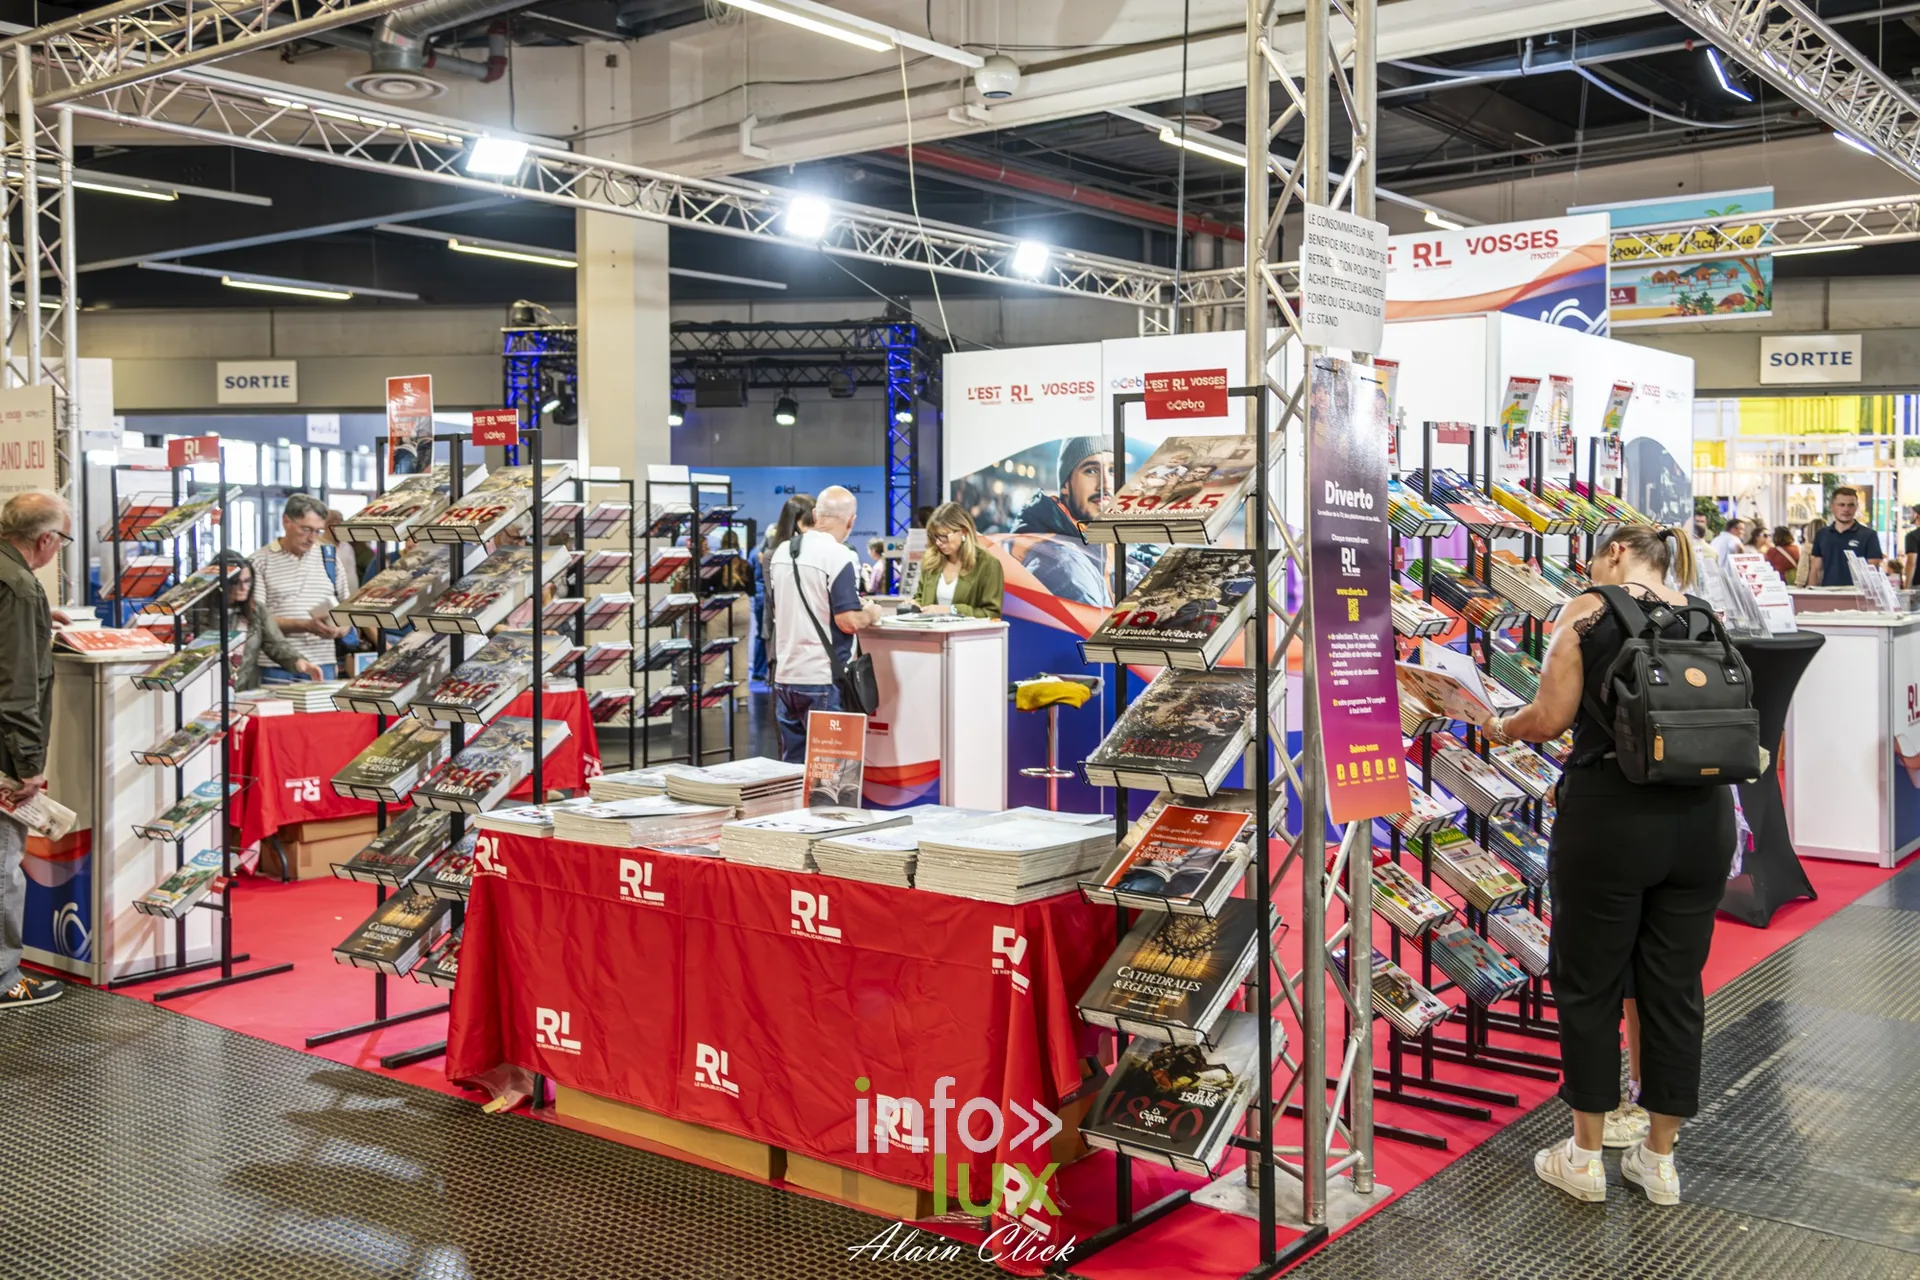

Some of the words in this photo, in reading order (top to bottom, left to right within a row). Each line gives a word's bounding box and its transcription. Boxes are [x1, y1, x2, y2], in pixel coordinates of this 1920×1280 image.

[1308, 213, 1316, 225] LE
[1317, 215, 1366, 238] CONSOMMATEUR
[1366, 230, 1374, 242] NE
[1308, 232, 1339, 250] BENEFICIE
[1340, 240, 1350, 254] PAS
[1413, 240, 1452, 268] RL
[1466, 229, 1559, 256] VOSGES
[1530, 250, 1560, 262] matin
[1308, 273, 1330, 287] ACHAT
[1330, 276, 1358, 293] EFFECTUE
[1307, 292, 1326, 306] FOIRE
[1328, 296, 1338, 308] OU
[1339, 298, 1346, 310] CE
[1346, 300, 1364, 312] SALON
[1306, 312, 1316, 324] CE
[1317, 314, 1339, 328] STAND
[1770, 351, 1853, 366] SORTIE
[225, 375, 290, 389] SORTIE
[968, 386, 1002, 400] L'EST
[1011, 384, 1034, 402] RL
[1042, 380, 1095, 396] VOSGES
[1146, 380, 1169, 390] L'EST
[1172, 378, 1188, 390] RL
[1190, 376, 1226, 387] VOSGES
[25, 440, 45, 470] JEU
[1325, 480, 1374, 510] Diverto
[830, 720, 842, 731] RL
[1192, 814, 1210, 824] RL
[620, 858, 665, 902] RL
[790, 888, 842, 938] RL
[1116, 966, 1202, 992] CATHÉDRALES
[536, 1006, 582, 1050] RL
[695, 1042, 739, 1094] RL
[1104, 1090, 1204, 1138] 1870
